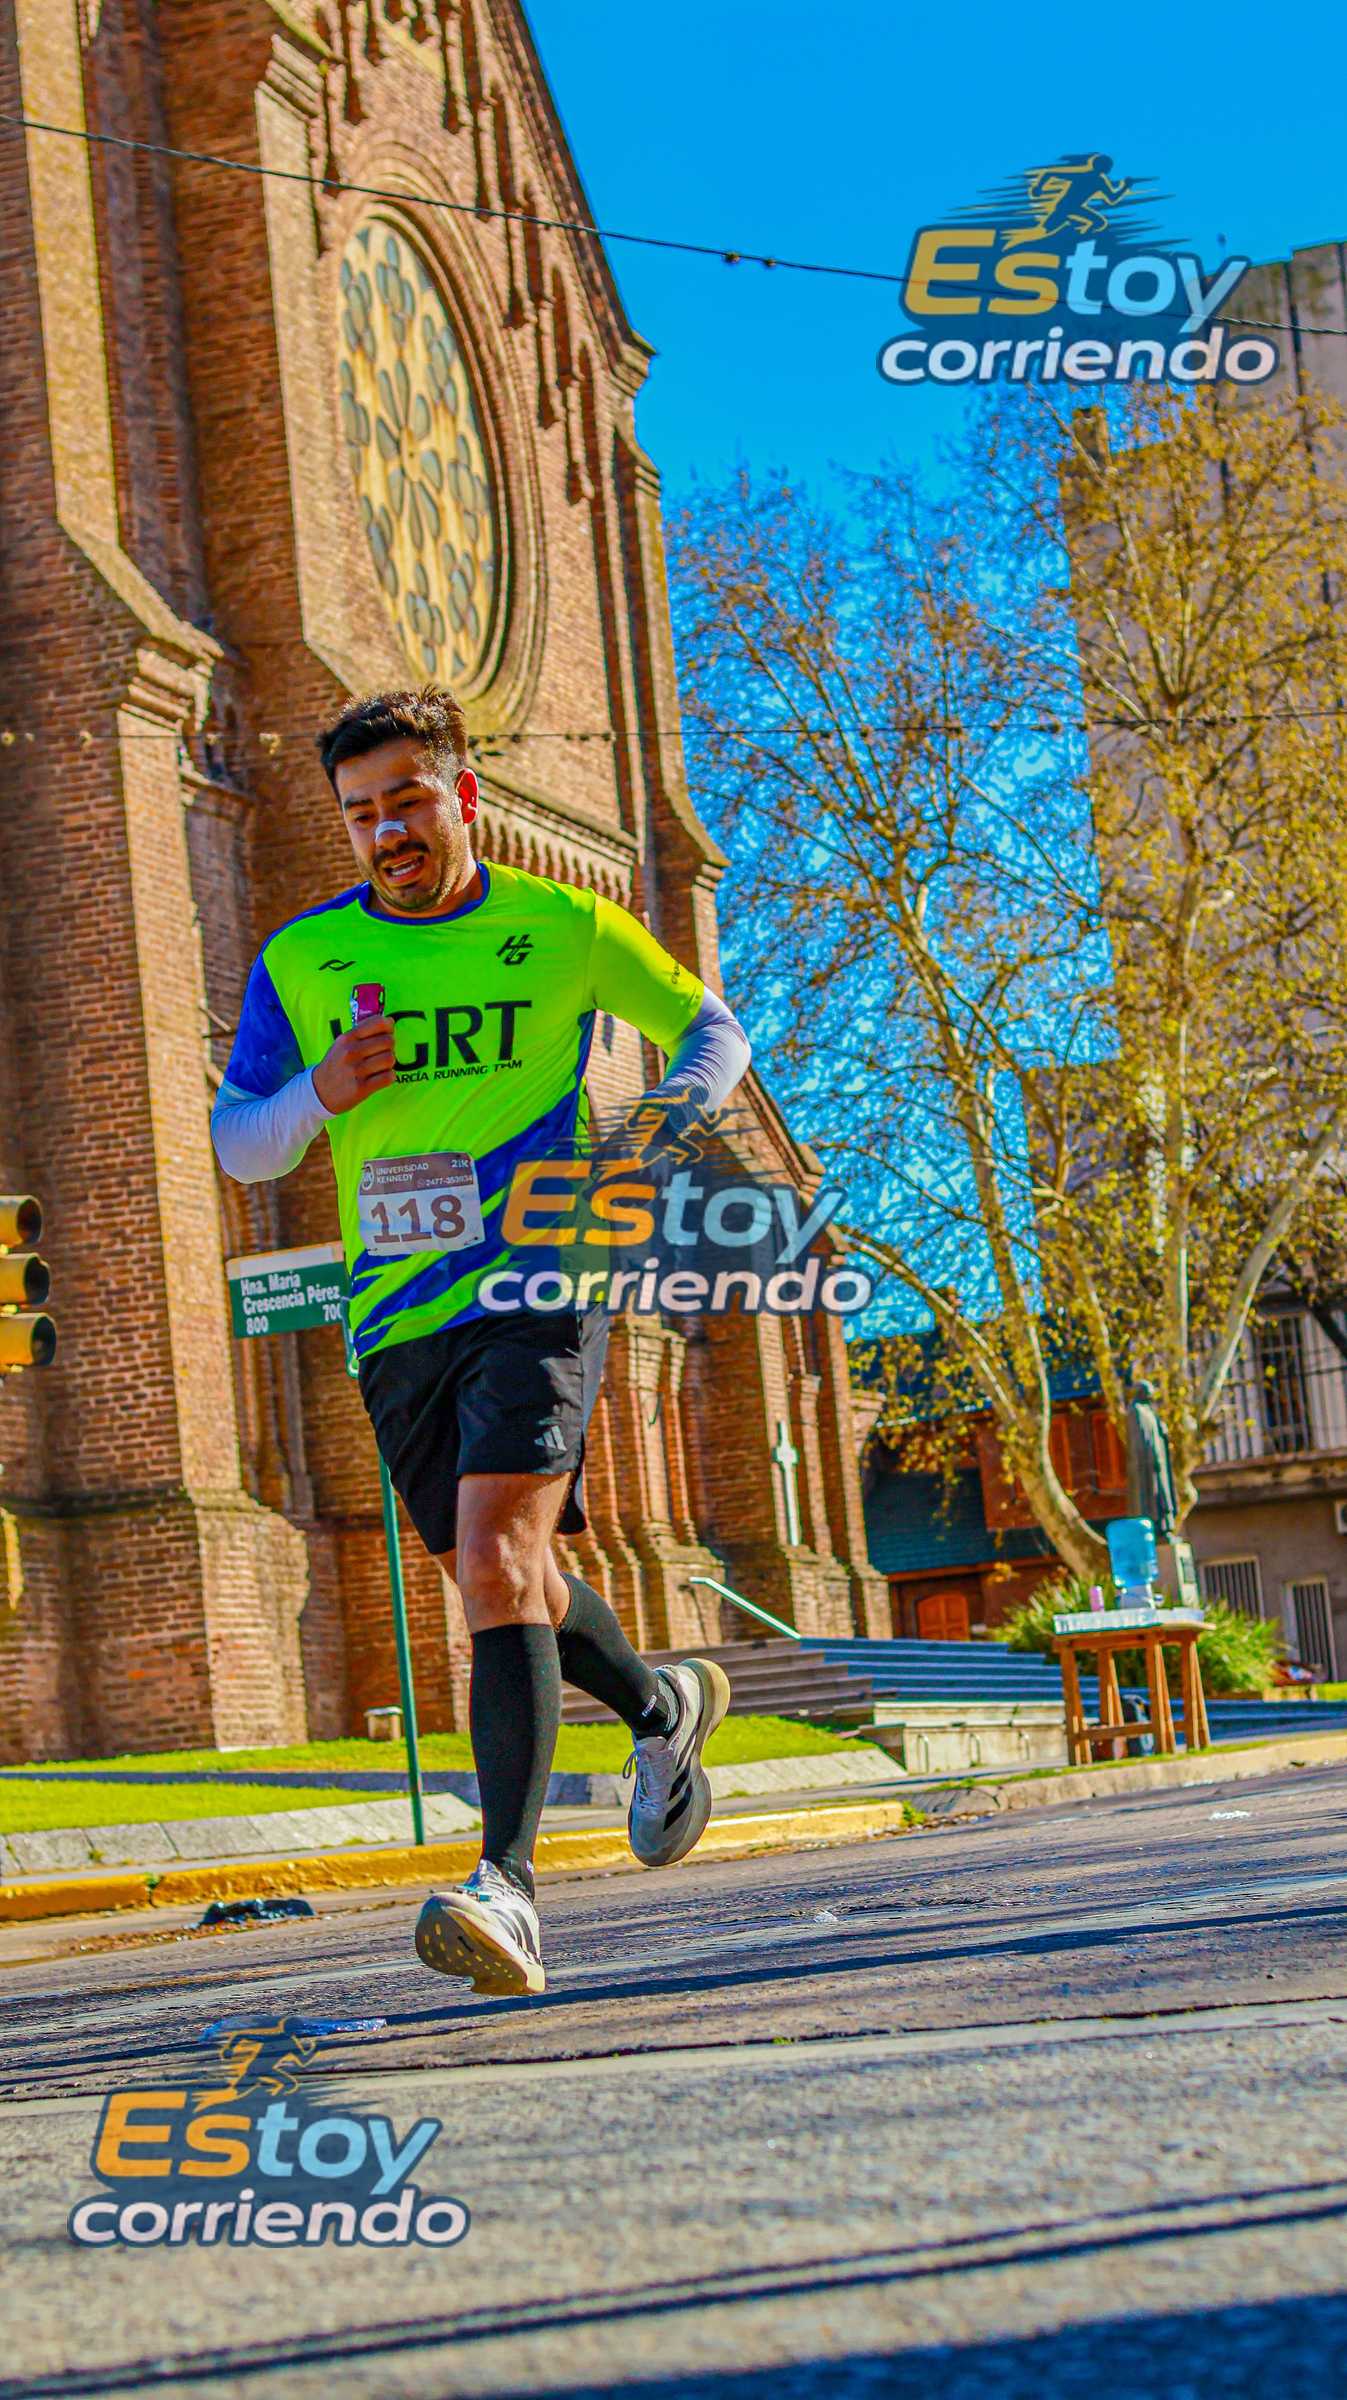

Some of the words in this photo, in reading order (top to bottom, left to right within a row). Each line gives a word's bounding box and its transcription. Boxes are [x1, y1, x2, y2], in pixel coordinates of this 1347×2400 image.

[329, 1000, 532, 1072] GRT
[395, 1069, 430, 1085] ARCÍA
[433, 1065, 489, 1080] RUNNING
[376, 1162, 430, 1176] UNIVERSIDAD
[376, 1172, 414, 1185] KENNEDY
[371, 1194, 466, 1243] 118
[240, 1279, 267, 1297] Hna.
[268, 1269, 302, 1292] María
[242, 1289, 306, 1316] Crescencia
[306, 1283, 340, 1304] Pérez
[246, 1315, 269, 1335] 800
